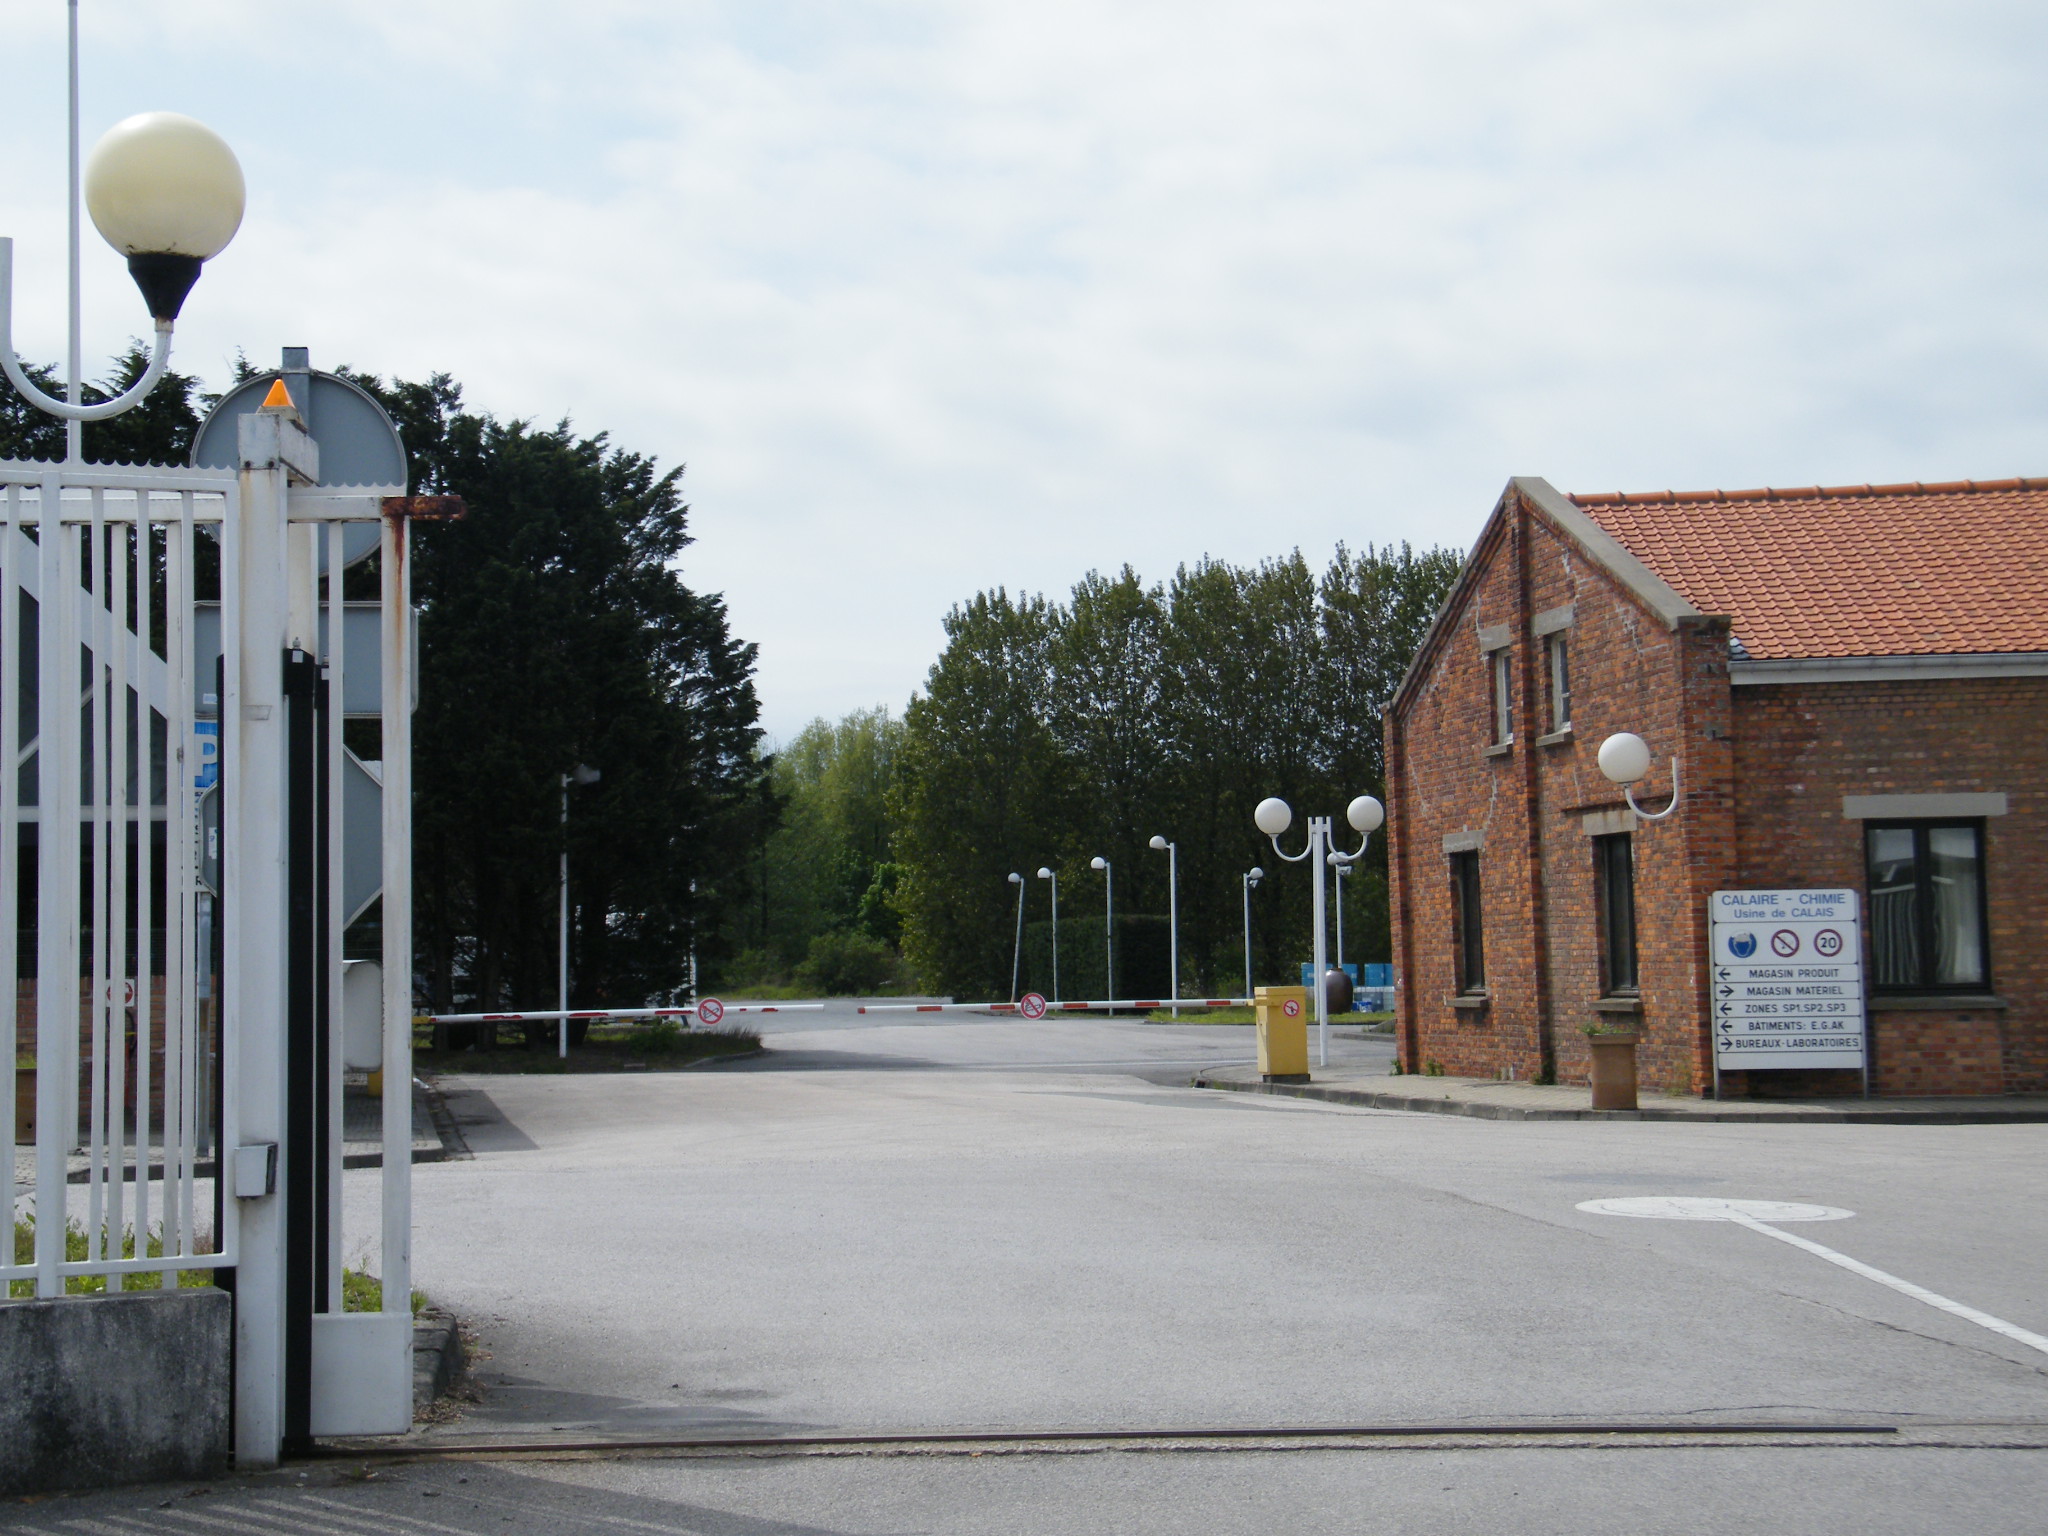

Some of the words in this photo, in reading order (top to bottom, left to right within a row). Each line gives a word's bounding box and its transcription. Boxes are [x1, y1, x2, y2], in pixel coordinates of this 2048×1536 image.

[194, 734, 217, 777] P
[1721, 894, 1779, 906] CALAIRE
[1799, 893, 1846, 904] CHIMIE
[1734, 908, 1766, 919] Usine
[1771, 908, 1786, 918] de
[1791, 907, 1834, 917] CALAIS
[1820, 937, 1837, 949] 20
[1749, 969, 1793, 978] MAGASIN
[1798, 968, 1839, 978] PRODUIT
[1747, 987, 1791, 996] MAGASIN
[1745, 1004, 1778, 1013] ZONES
